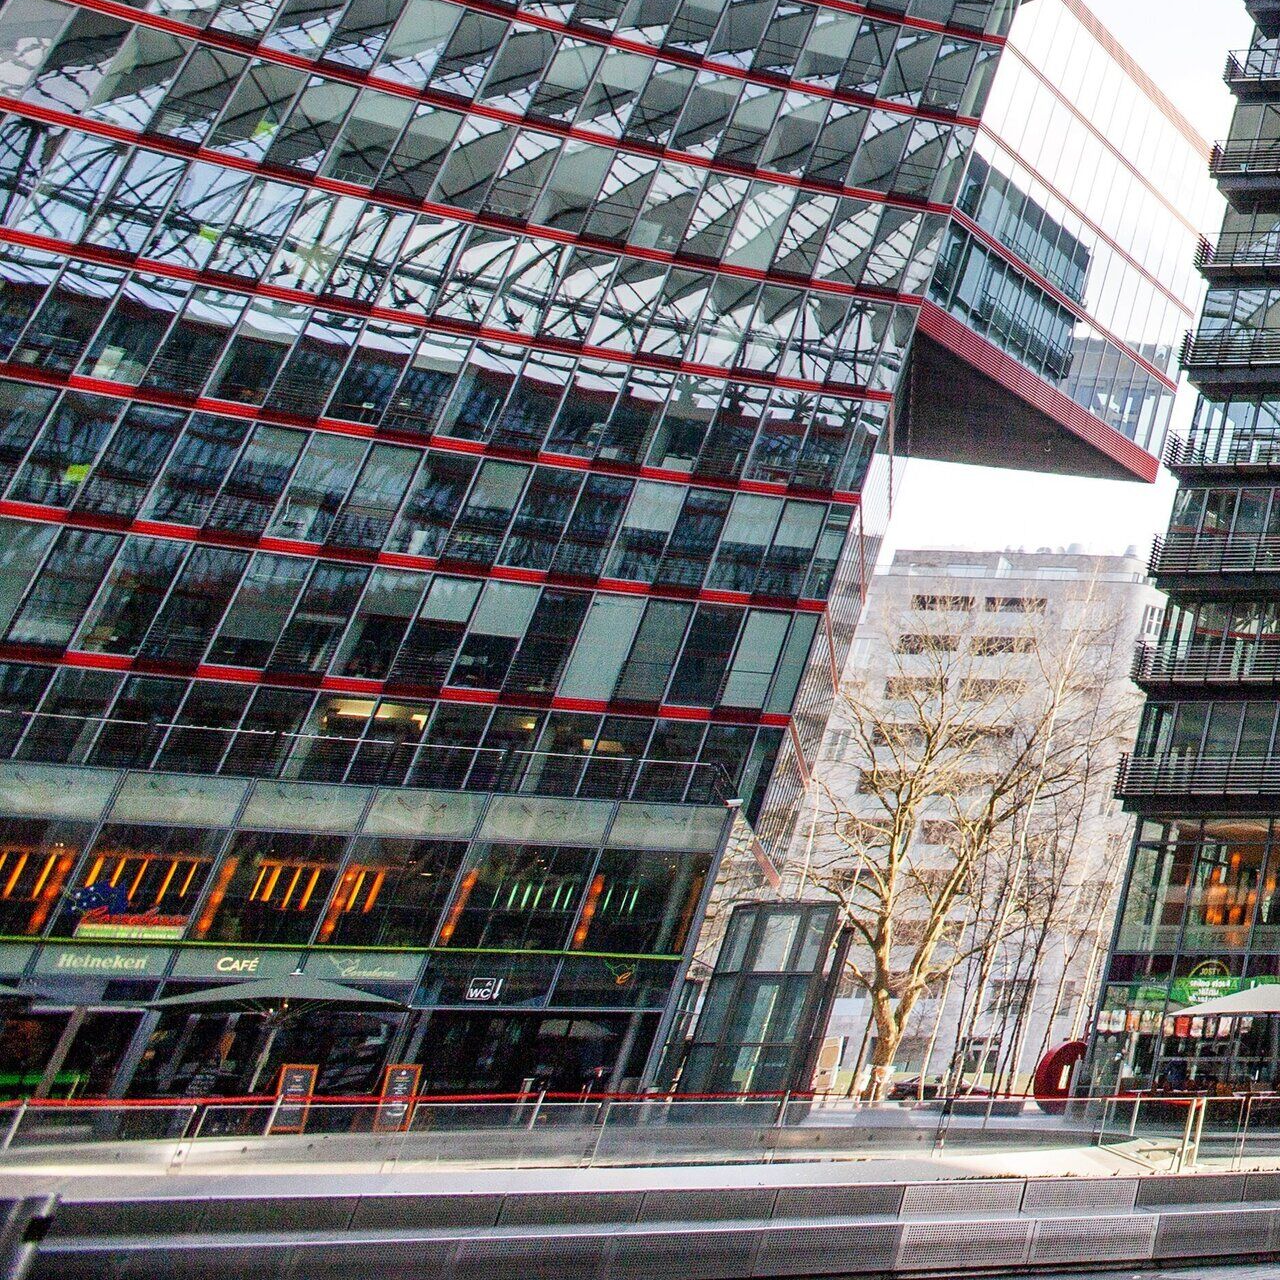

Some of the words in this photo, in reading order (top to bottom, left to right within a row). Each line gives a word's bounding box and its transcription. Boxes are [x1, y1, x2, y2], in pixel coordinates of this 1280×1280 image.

[57, 953, 149, 970] Heineken
[216, 956, 260, 972] CAFÉ
[468, 988, 491, 998] WC
